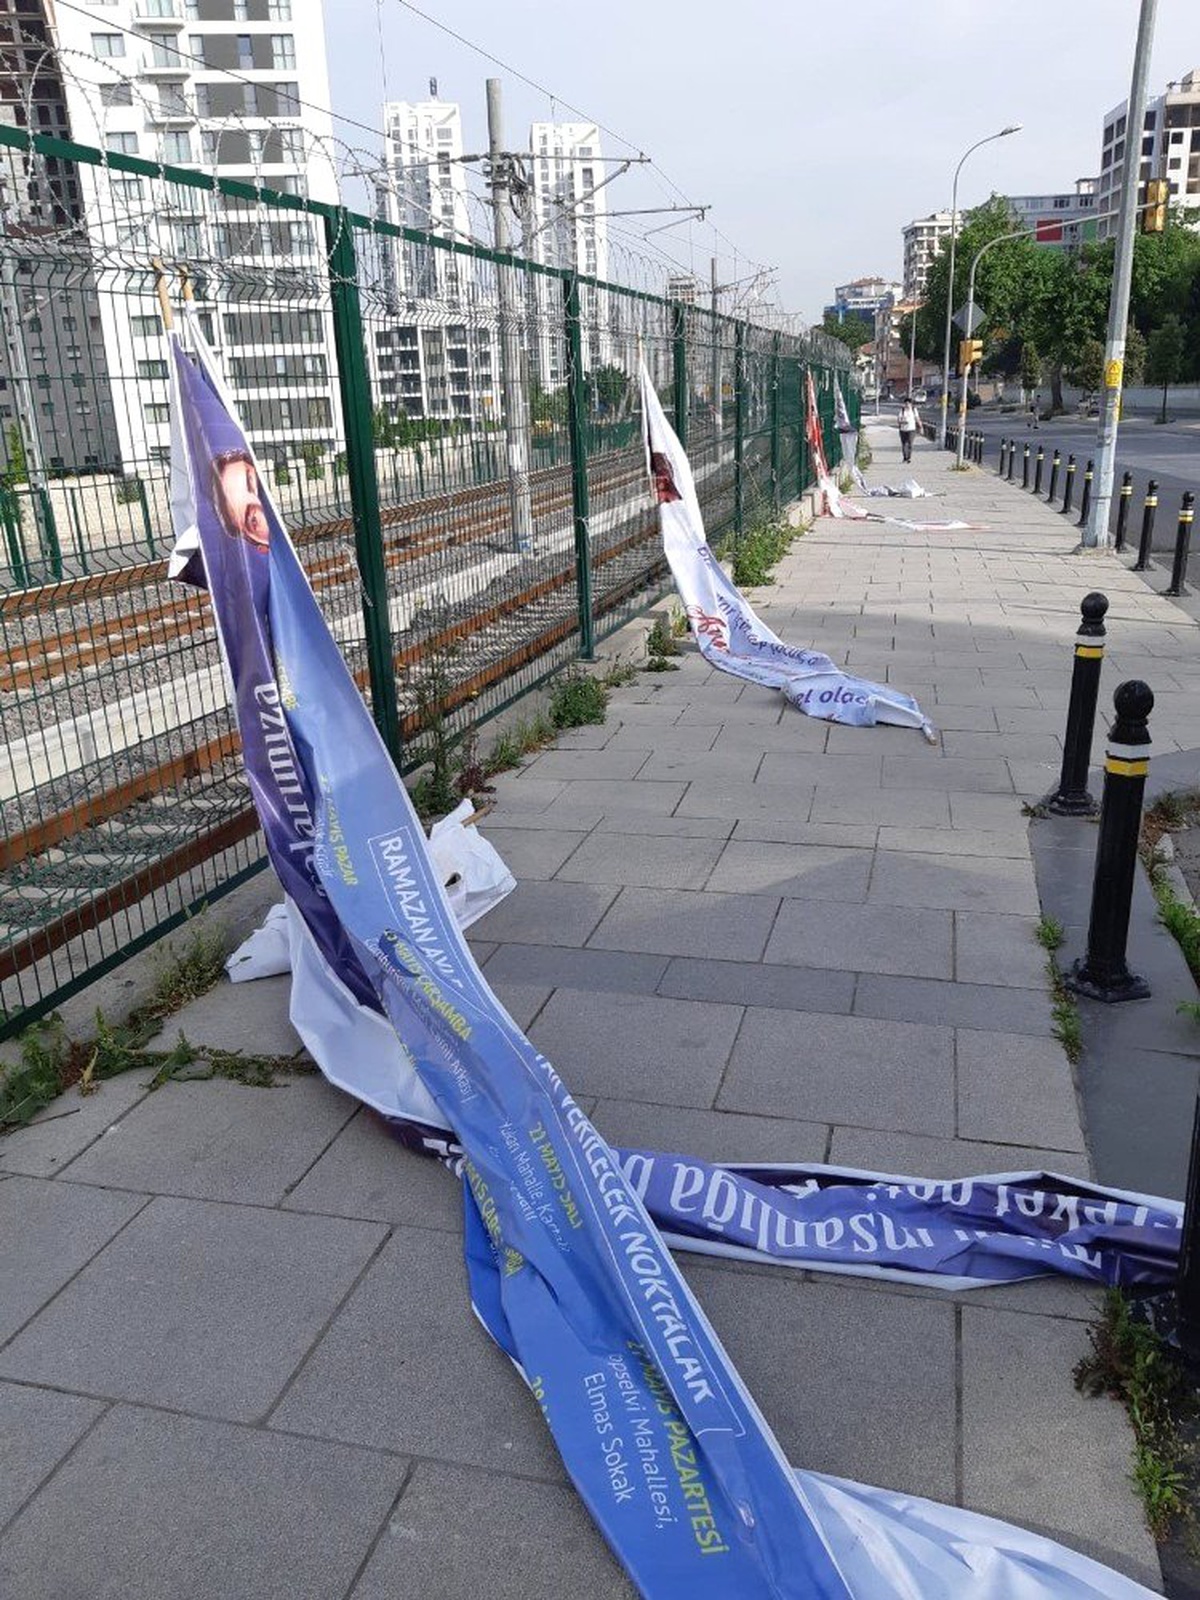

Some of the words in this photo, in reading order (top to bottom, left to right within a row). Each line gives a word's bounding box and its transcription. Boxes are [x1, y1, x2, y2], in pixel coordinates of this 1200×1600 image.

[333, 844, 358, 886] PAZAR
[379, 836, 439, 942] RAMAZAN
[537, 1142, 567, 1190] MAYIS
[559, 1190, 584, 1230] SALI
[582, 1371, 614, 1436] Elmas
[600, 1436, 637, 1504] Sokak
[629, 1416, 680, 1531] Mahallesi,
[662, 1419, 730, 1555] PAZARTESİ
